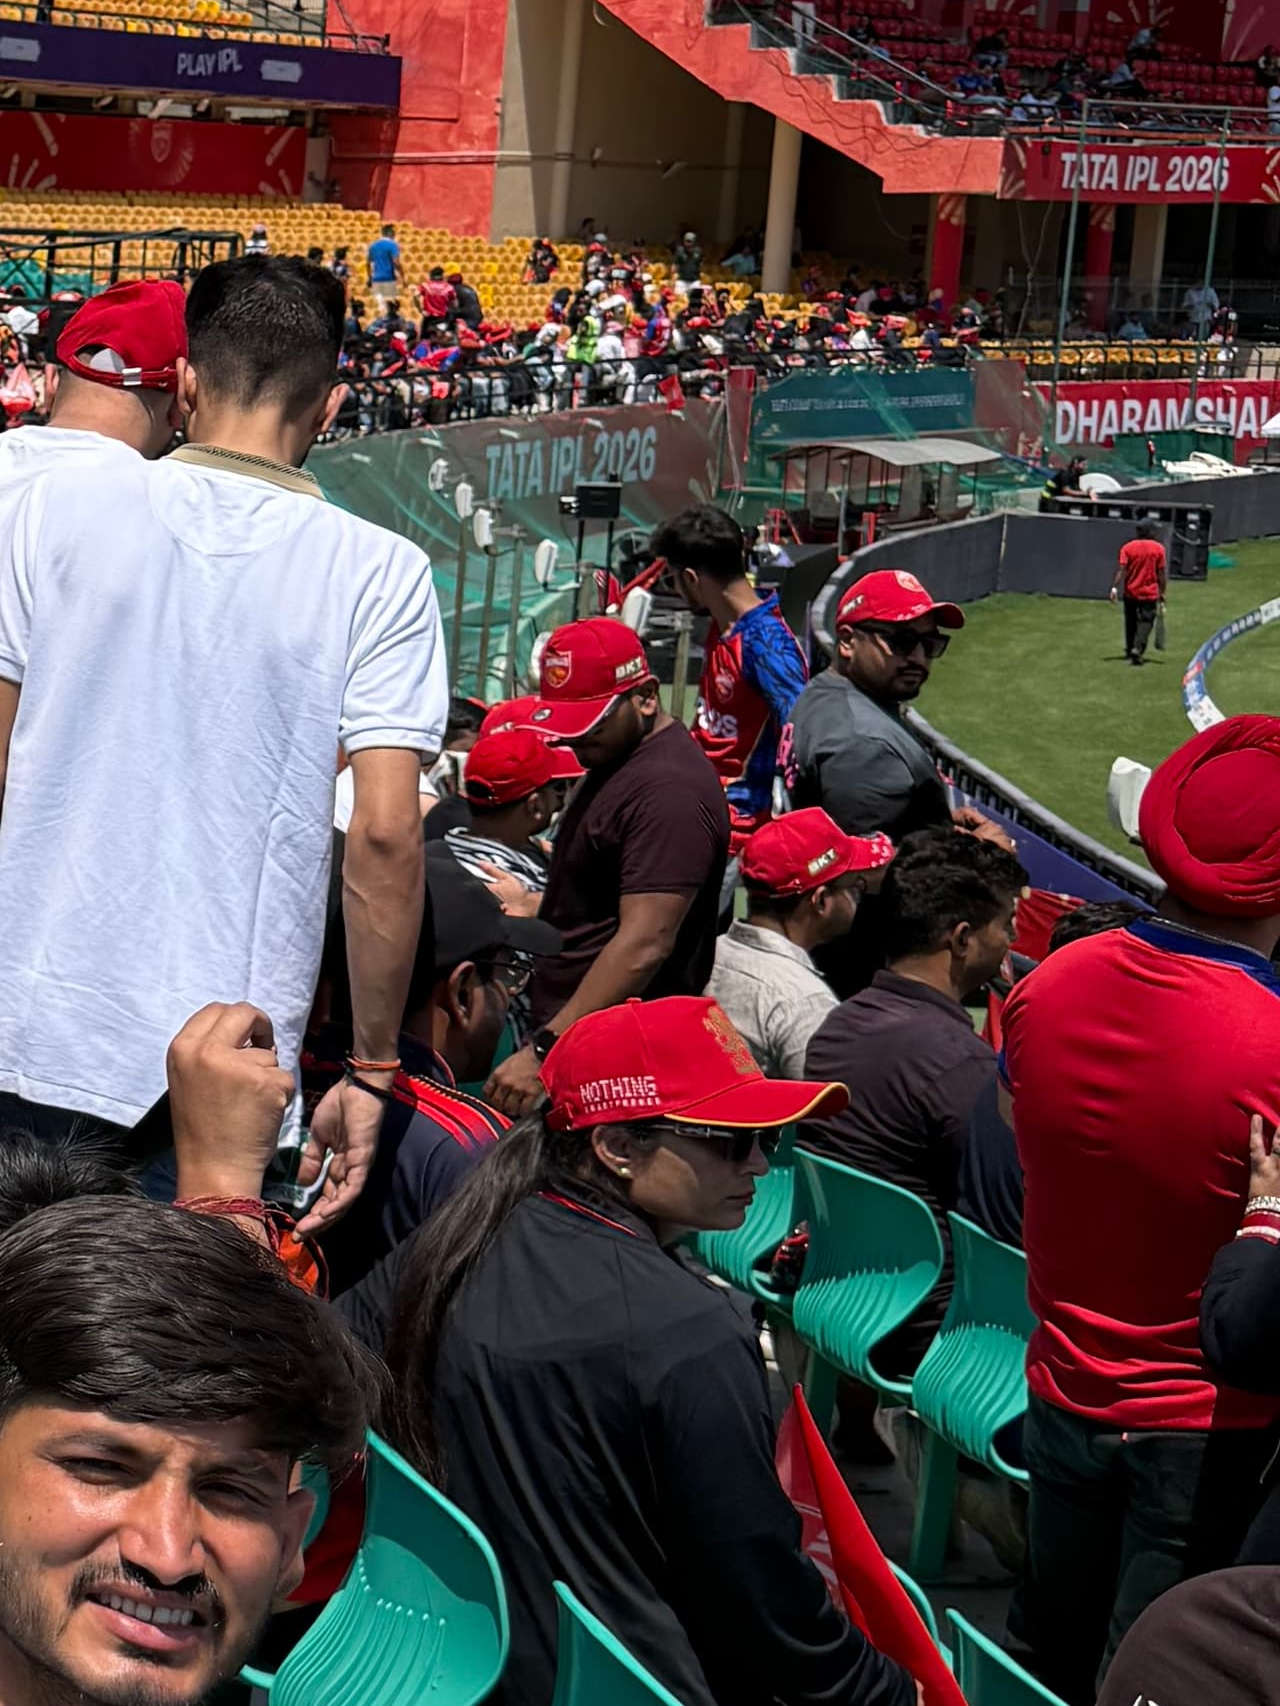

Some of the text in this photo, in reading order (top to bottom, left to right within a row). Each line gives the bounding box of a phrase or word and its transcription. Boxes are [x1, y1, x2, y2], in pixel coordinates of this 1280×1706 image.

[176, 48, 243, 77] PLAY IPL
[1061, 151, 1230, 192] TATA IPL 2026
[486, 425, 657, 500] TATA IPL 2026
[580, 1075, 656, 1104] NOTHING
